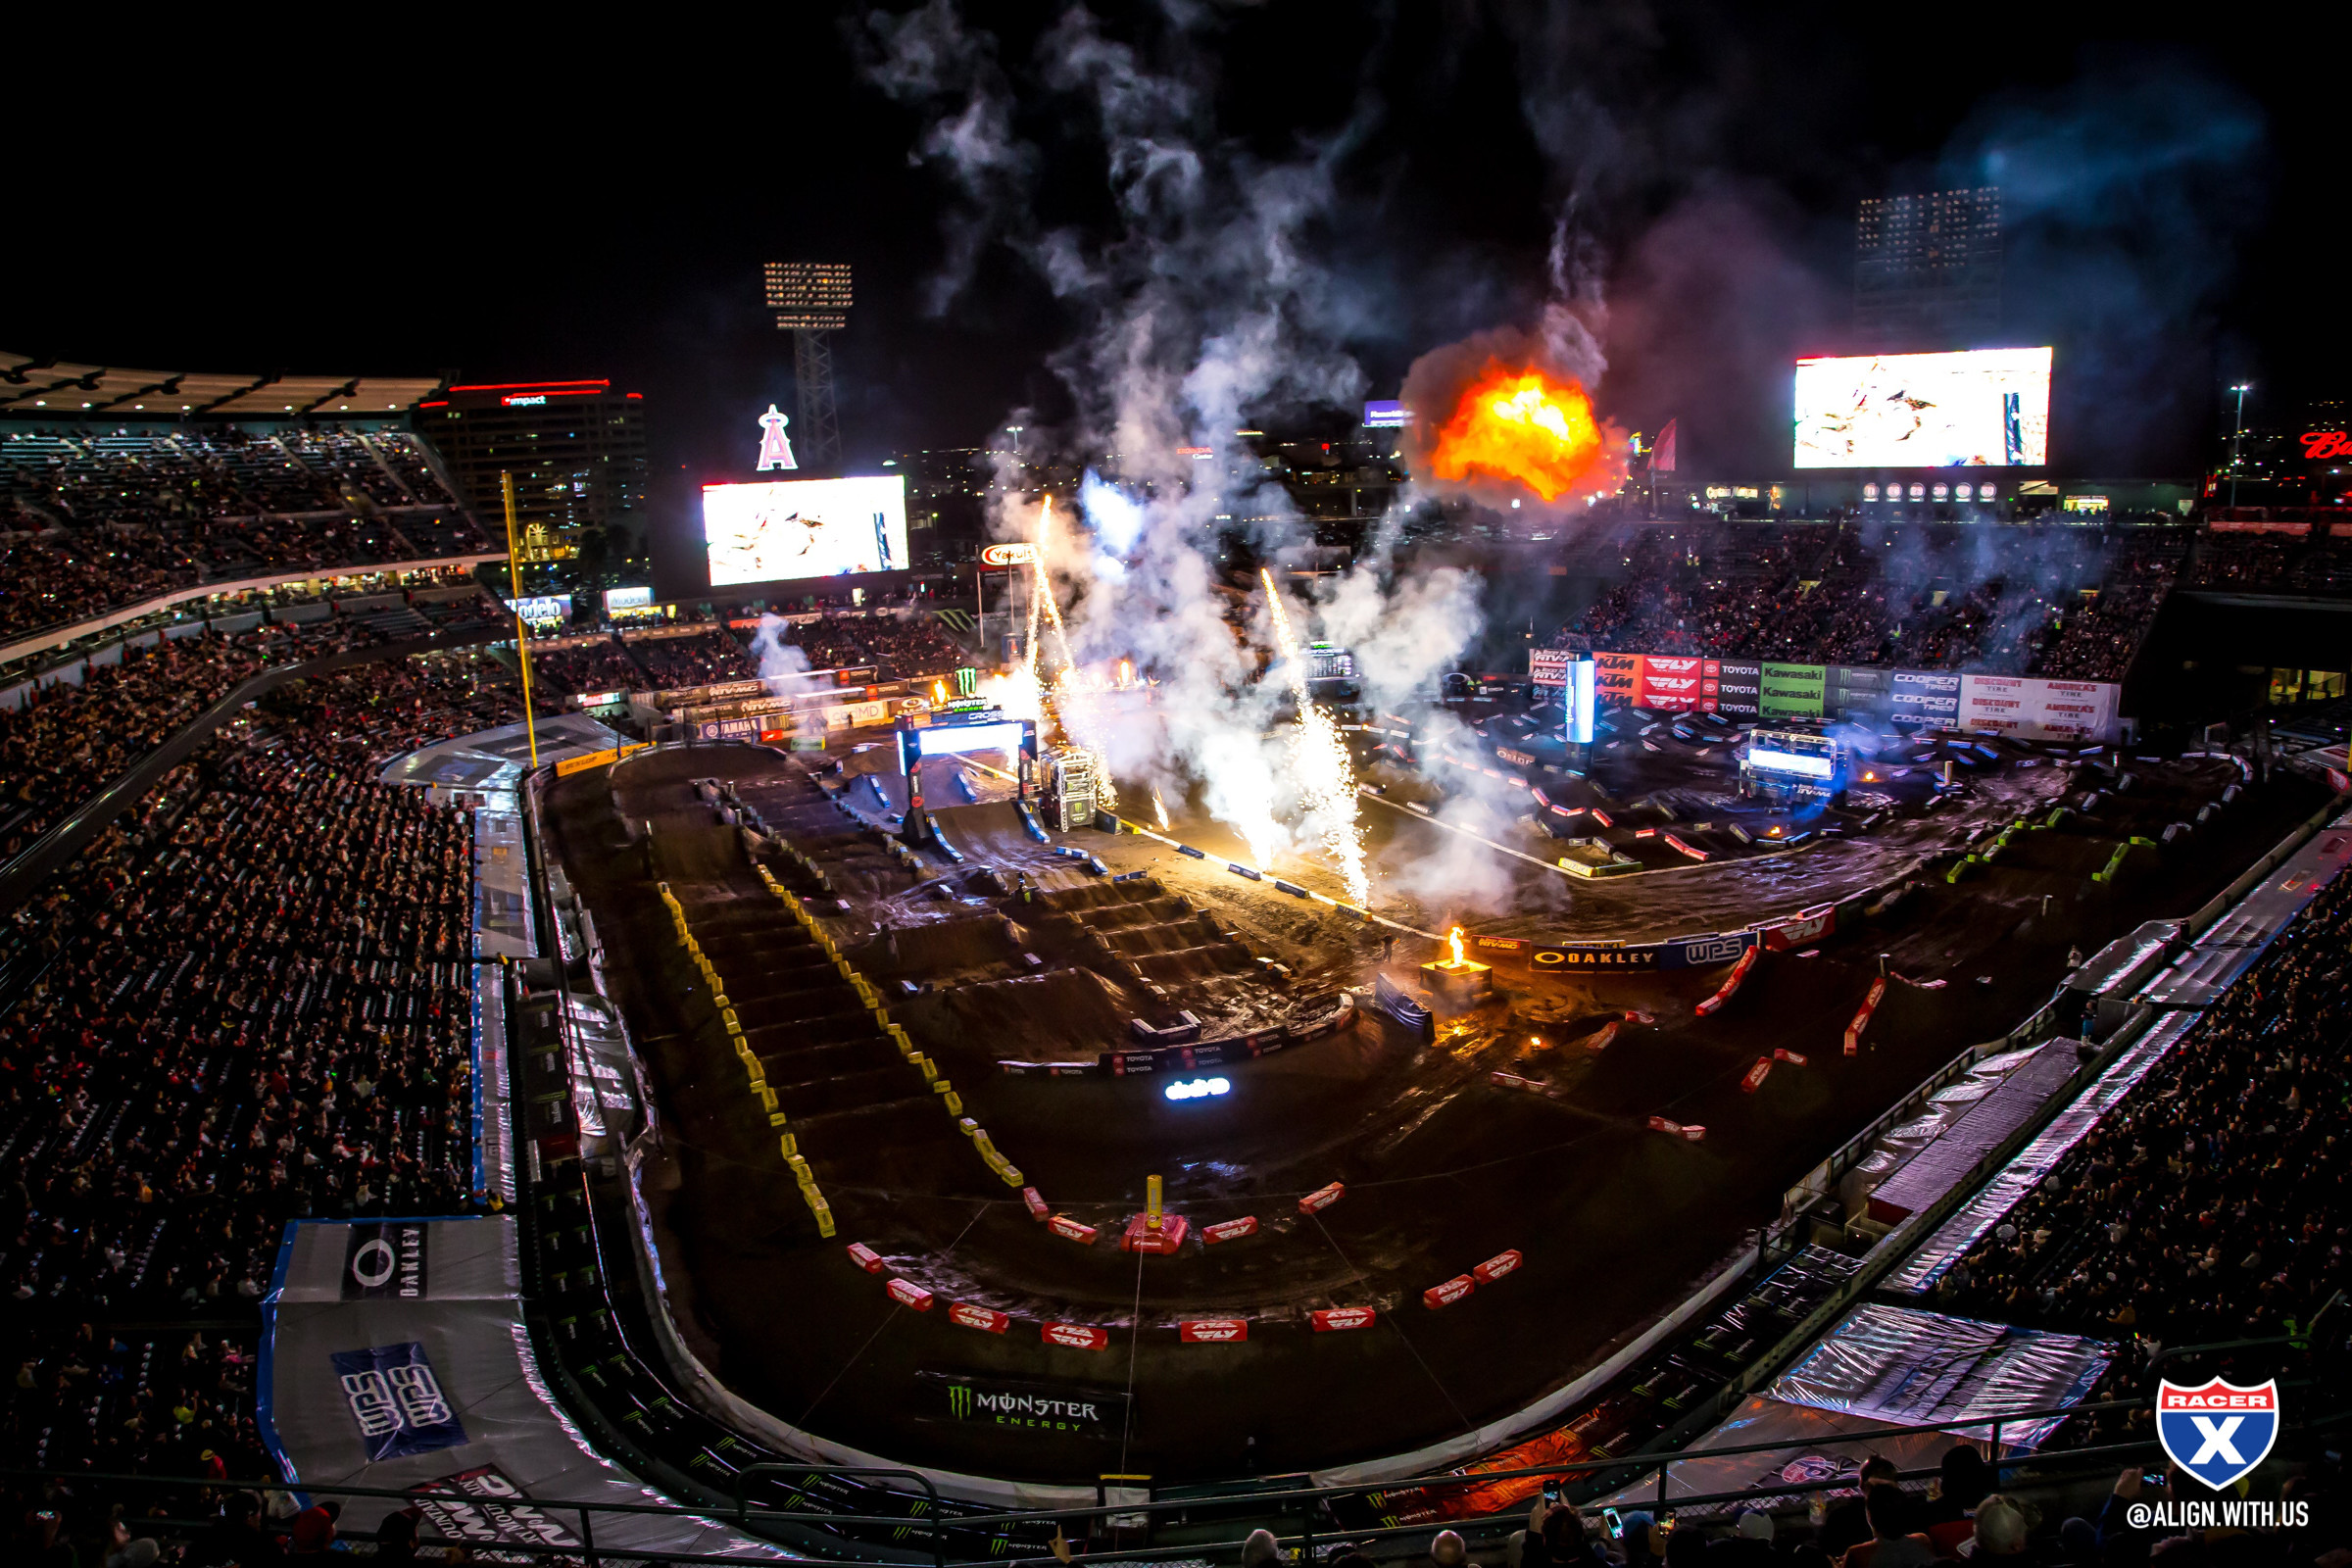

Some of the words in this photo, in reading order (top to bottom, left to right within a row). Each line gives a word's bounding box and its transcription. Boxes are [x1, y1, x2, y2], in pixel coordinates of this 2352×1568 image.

[994, 550, 1033, 560] Yakult
[1596, 655, 1635, 670] KTM
[1646, 658, 1697, 670] FLY
[1722, 665, 1759, 676] TOYOTA
[1764, 667, 1823, 681] Kawasaki
[1595, 673, 1634, 689] KTM
[1645, 676, 1696, 690] FLY
[1893, 673, 1960, 686] COOPER
[1974, 677, 2022, 688] DISCOUNT
[877, 685, 900, 696] TOYOTA
[1721, 684, 1757, 696] TOYOTA
[1763, 686, 1821, 701] Kawasaki
[2047, 682, 2097, 693] AMERICA'S
[1891, 693, 1958, 706] COOPER
[1972, 698, 2021, 709] DISCOUNT
[1720, 704, 1757, 714] TOYOTA
[1923, 704, 1956, 712] TIRES
[2045, 703, 2095, 713] AMERICA'S
[1890, 713, 1956, 726] COOPER
[1779, 915, 1828, 942] FLY
[1687, 937, 1741, 964] WPS
[1567, 953, 1653, 963] OAKLEY
[1054, 1223, 1086, 1239] FLY
[1215, 1224, 1251, 1240] FLY
[400, 1228, 421, 1298] OAKLEY
[956, 1313, 995, 1329] FLY
[1327, 1316, 1369, 1328] FLY
[1050, 1333, 1094, 1347] FLY
[1191, 1329, 1240, 1340] FLY
[388, 1363, 452, 1429] WPS
[340, 1370, 404, 1438] WPS
[976, 1392, 1100, 1422] MONSTER
[996, 1415, 1082, 1432] ENERGY
